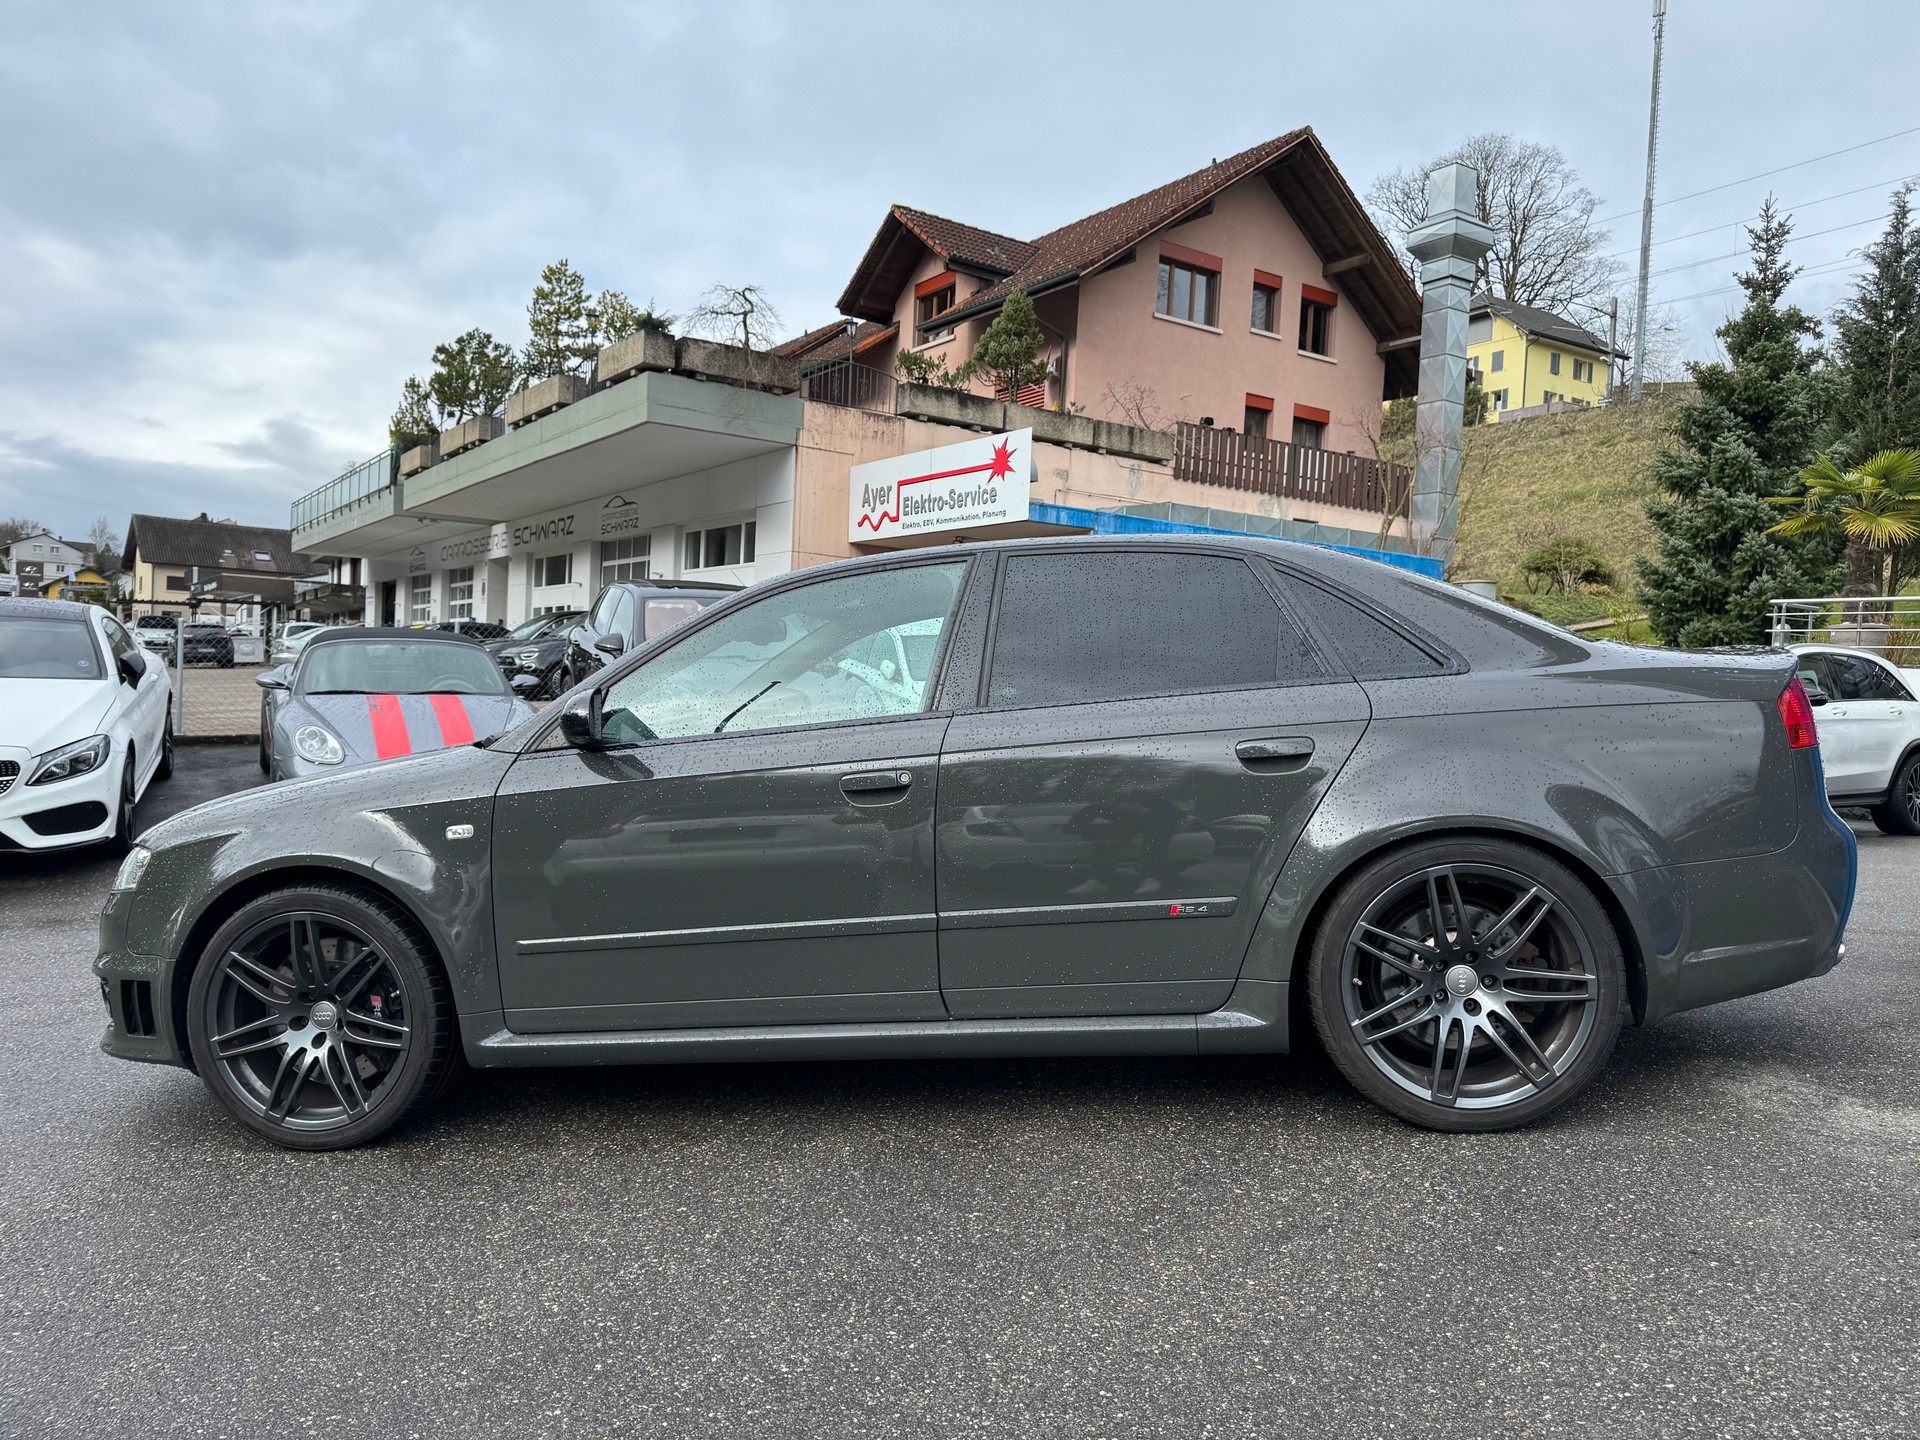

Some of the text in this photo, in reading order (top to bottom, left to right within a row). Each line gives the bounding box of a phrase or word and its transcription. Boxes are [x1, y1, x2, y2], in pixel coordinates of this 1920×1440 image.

[861, 483, 893, 513] Ayer
[600, 517, 639, 535] SCHWARZ
[902, 509, 1007, 530] Elektro, EDV, Kommunikation, Planung
[441, 515, 575, 561] CARROSSERIE SCHWARZ
[1176, 905, 1208, 913] RS 4
